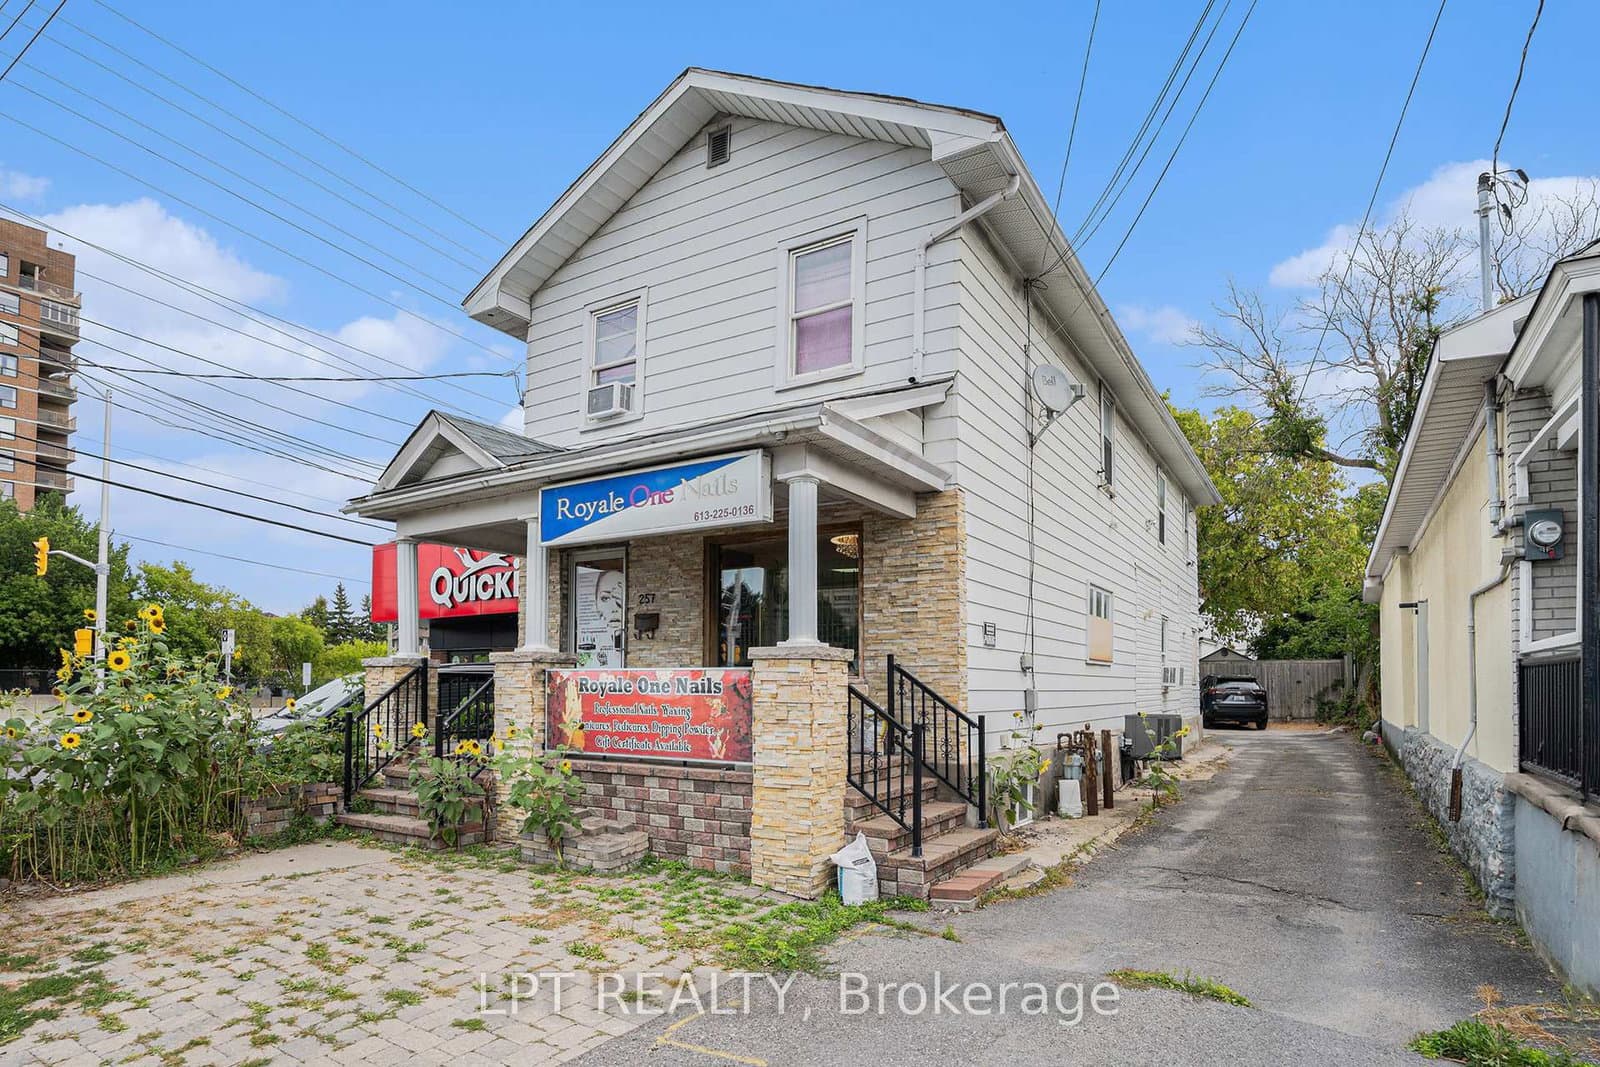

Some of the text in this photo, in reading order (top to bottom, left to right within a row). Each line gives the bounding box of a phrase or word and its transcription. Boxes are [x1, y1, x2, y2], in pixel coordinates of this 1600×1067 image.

[556, 477, 738, 521] Royale One Nails
[694, 504, 754, 522] 613-225-0136
[639, 593, 656, 604] 257
[578, 676, 723, 698] Royale One Nails
[594, 702, 637, 716] Professional
[661, 704, 691, 721] Waxing
[652, 721, 682, 738] Dipping
[595, 735, 610, 750] Gift
[611, 735, 651, 751] Certificate
